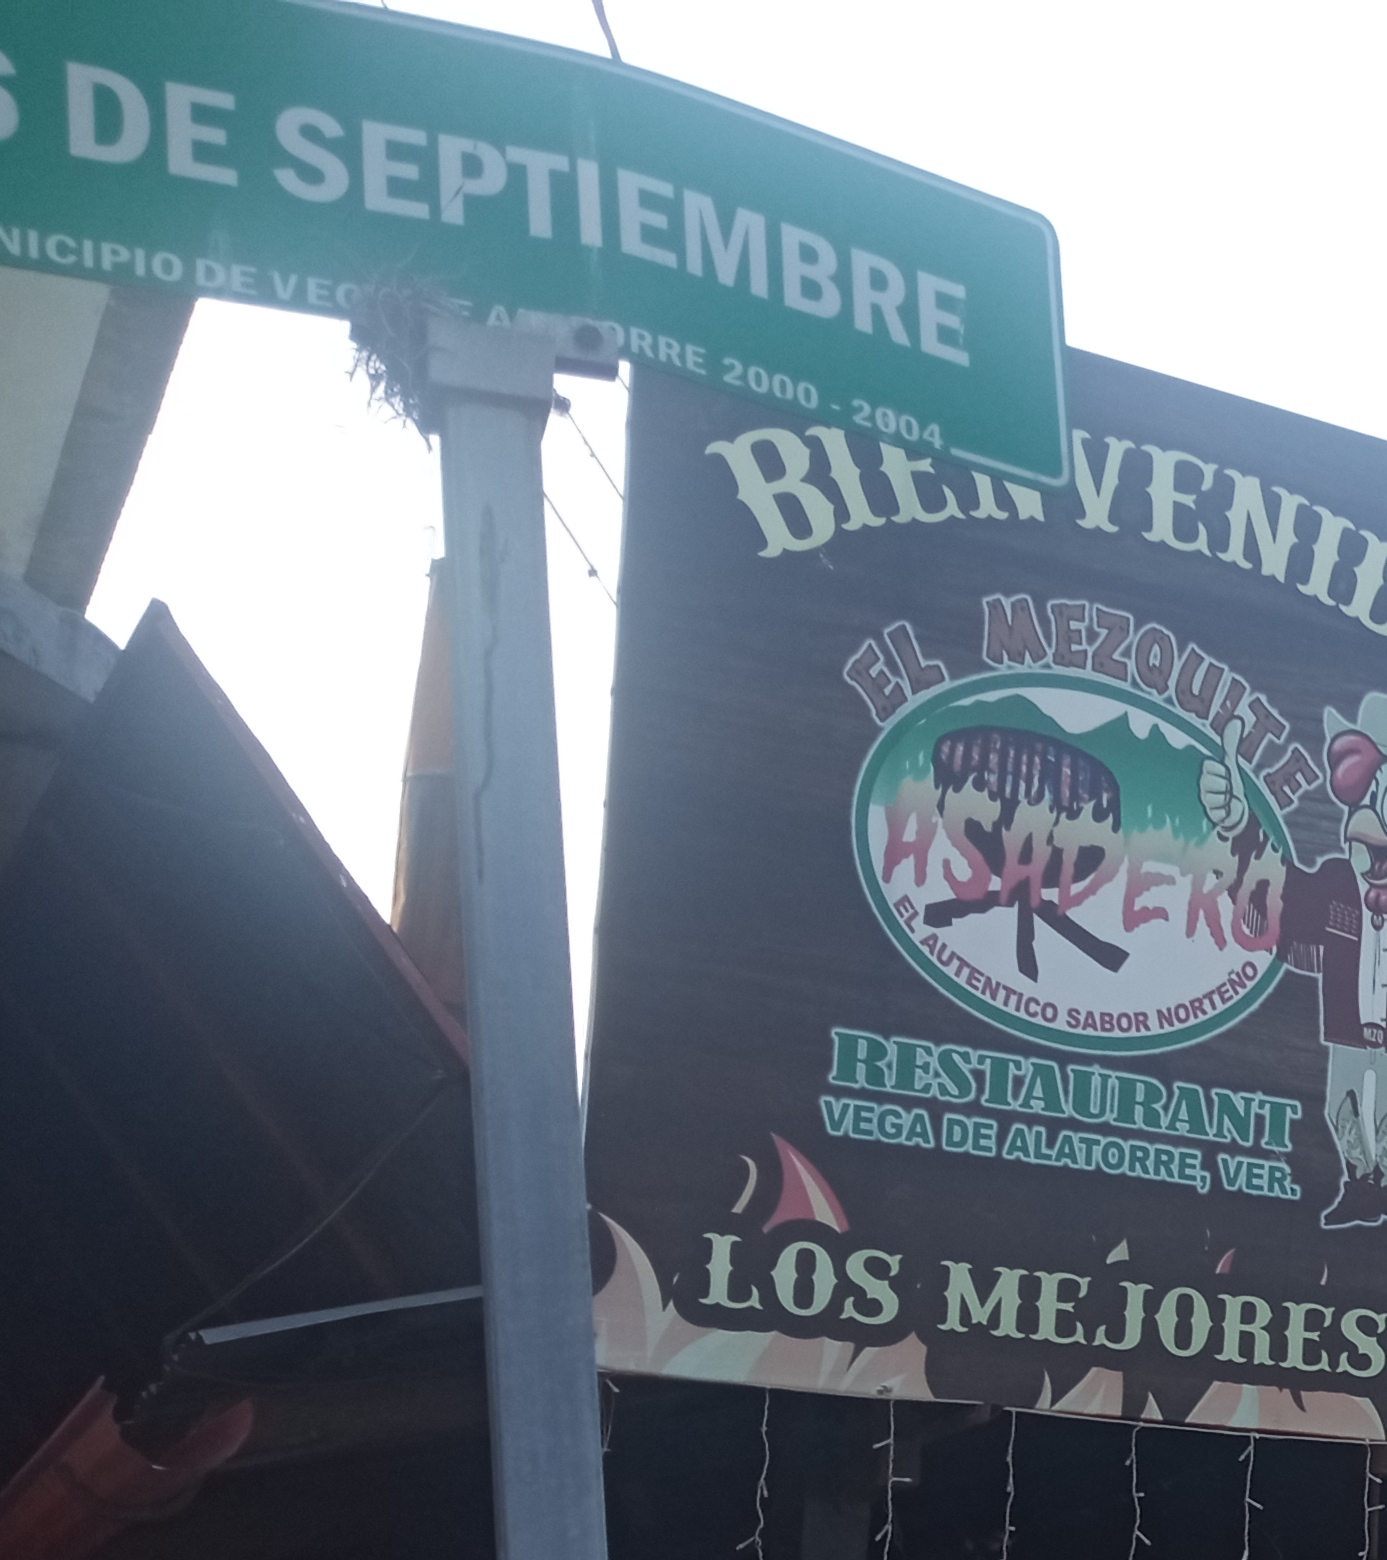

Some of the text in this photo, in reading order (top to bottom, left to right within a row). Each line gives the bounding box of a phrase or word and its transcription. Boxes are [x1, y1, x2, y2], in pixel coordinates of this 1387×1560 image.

[66, 60, 238, 187] DE
[271, 105, 971, 367] SEPTIEMBRE
[0, 226, 183, 282] NICIPIO
[196, 258, 256, 296] DE
[486, 303, 707, 375] AORRE
[722, 357, 819, 410] 2000
[851, 399, 943, 450] 2004
[845, 595, 1320, 812] EL MEZQUITE
[882, 772, 1287, 955] ASADERO
[893, 894, 1259, 1034] EL AUTENTICO SABOR NORTEÑO
[821, 1098, 1301, 1200] VEGA DE ALATORRE, VER.
[829, 1029, 1301, 1150] RESTAURANT
[698, 1231, 902, 1326] LOS
[937, 1259, 1387, 1382] MEJORES
